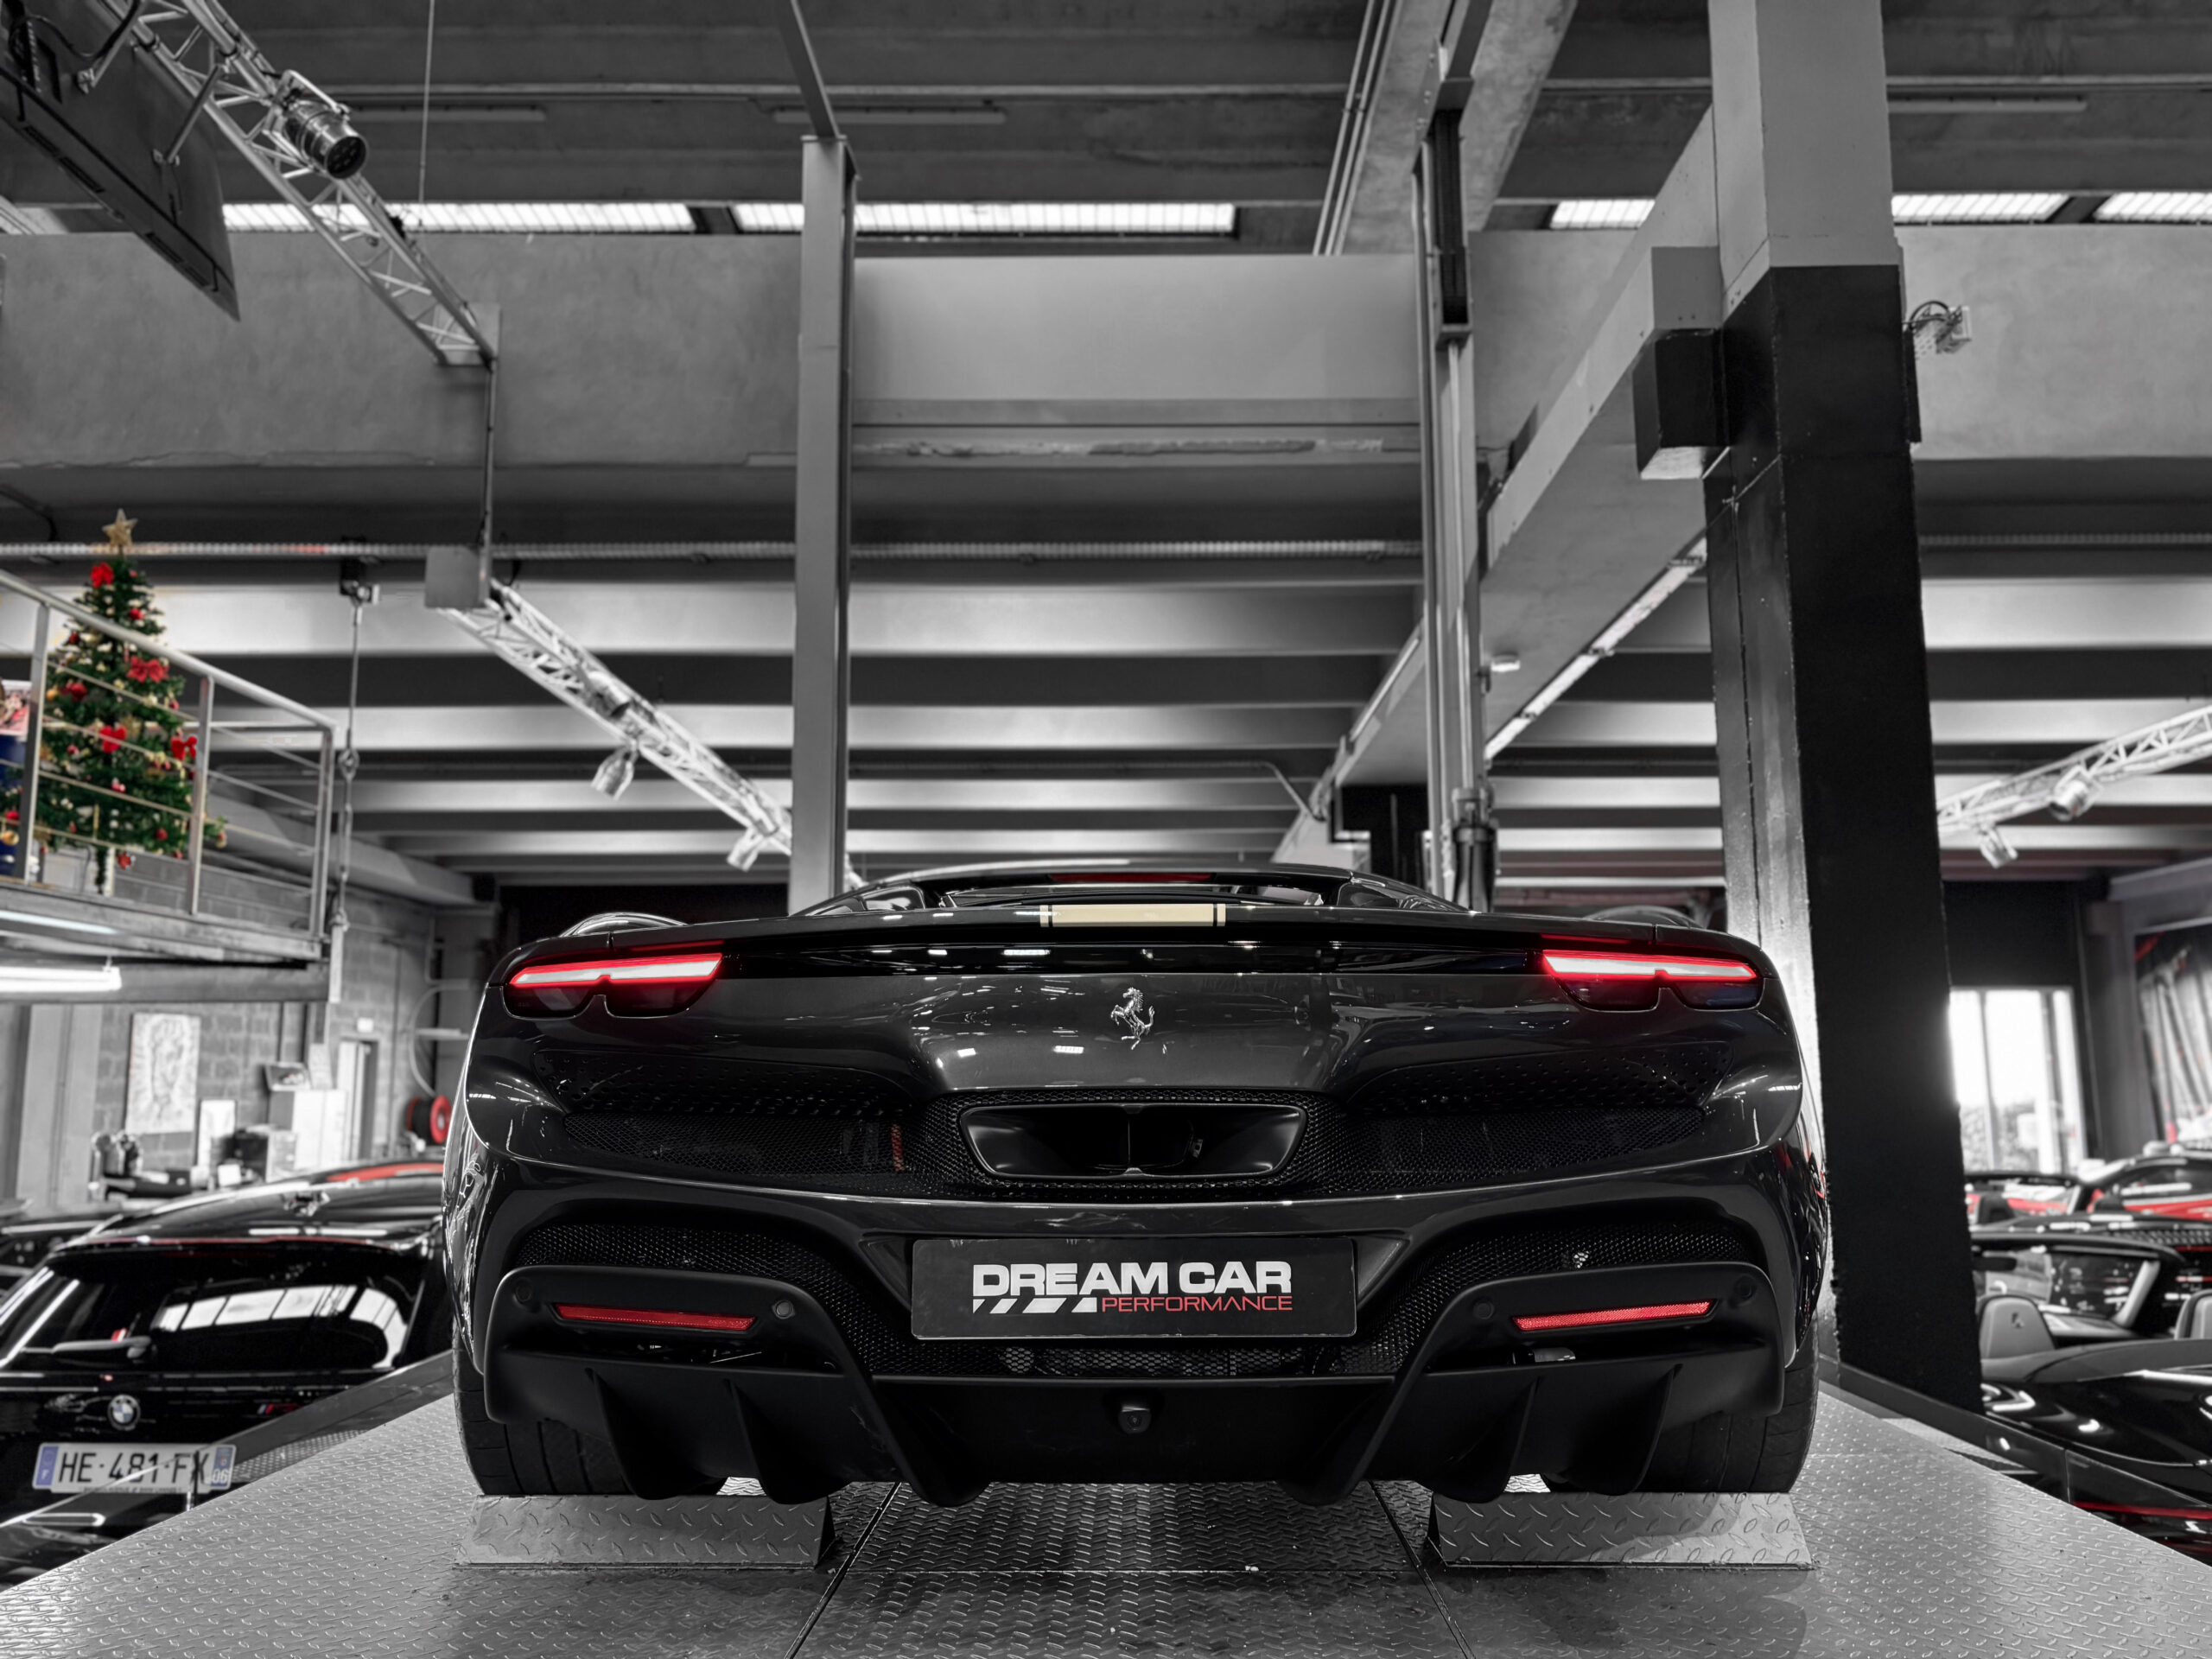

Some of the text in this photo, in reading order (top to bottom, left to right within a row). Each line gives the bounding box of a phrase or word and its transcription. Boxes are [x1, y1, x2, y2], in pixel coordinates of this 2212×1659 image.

[972, 1261, 1292, 1296] DREAM CAR
[1102, 1296, 1293, 1313] PERFORMANCE
[212, 1468, 229, 1484] 06
